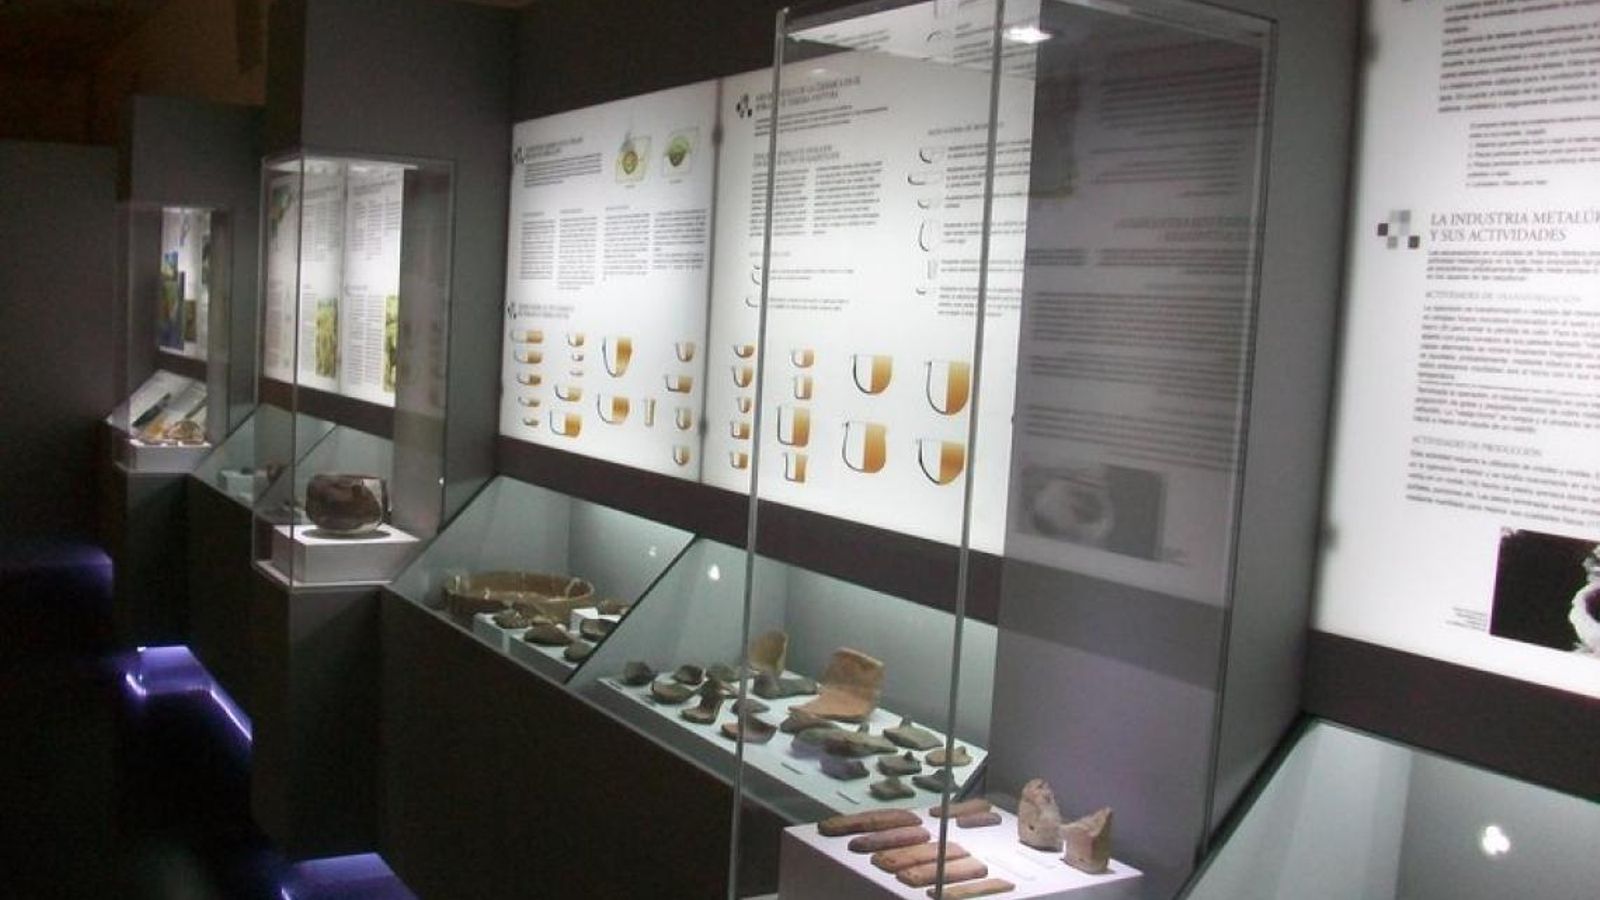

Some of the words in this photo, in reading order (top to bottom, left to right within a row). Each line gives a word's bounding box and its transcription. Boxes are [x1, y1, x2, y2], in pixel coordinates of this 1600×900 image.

[1430, 212, 1446, 226] LA
[1451, 211, 1528, 225] INDUSTRIA
[1430, 229, 1438, 241] Y
[1441, 229, 1466, 241] SUS
[1468, 228, 1567, 241] ACTIVIDADES
